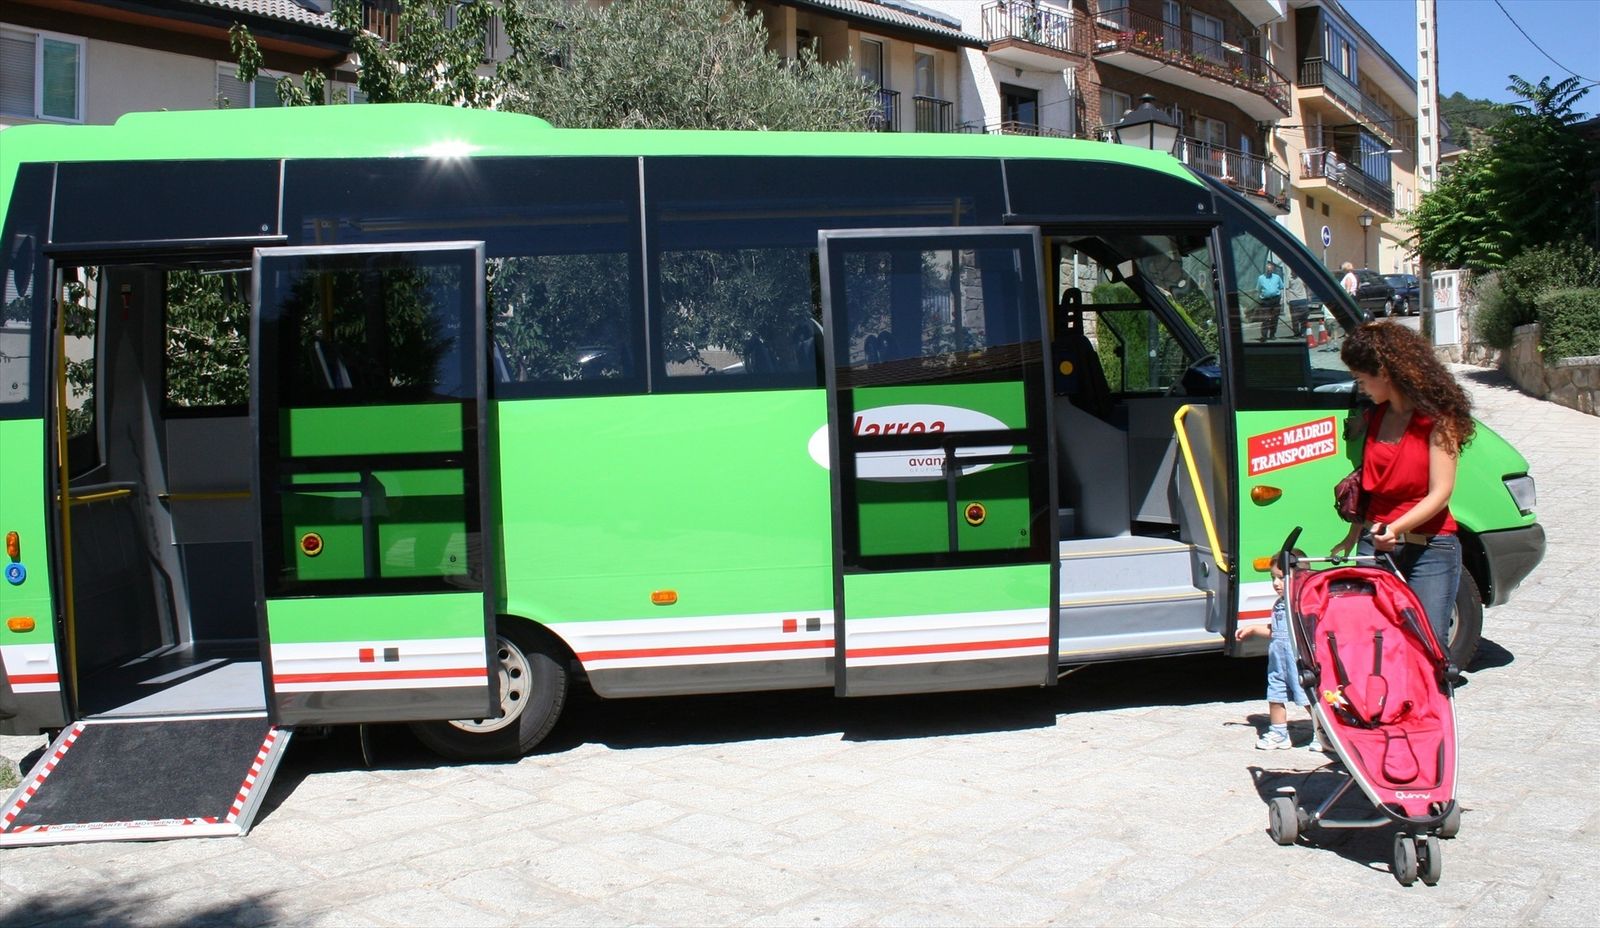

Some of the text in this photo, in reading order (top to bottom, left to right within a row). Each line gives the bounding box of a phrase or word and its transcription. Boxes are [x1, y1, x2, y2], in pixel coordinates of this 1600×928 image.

[1283, 421, 1333, 446] MADRID
[1251, 438, 1335, 473] TRANSPORTES
[1395, 791, 1430, 800] Quinny
